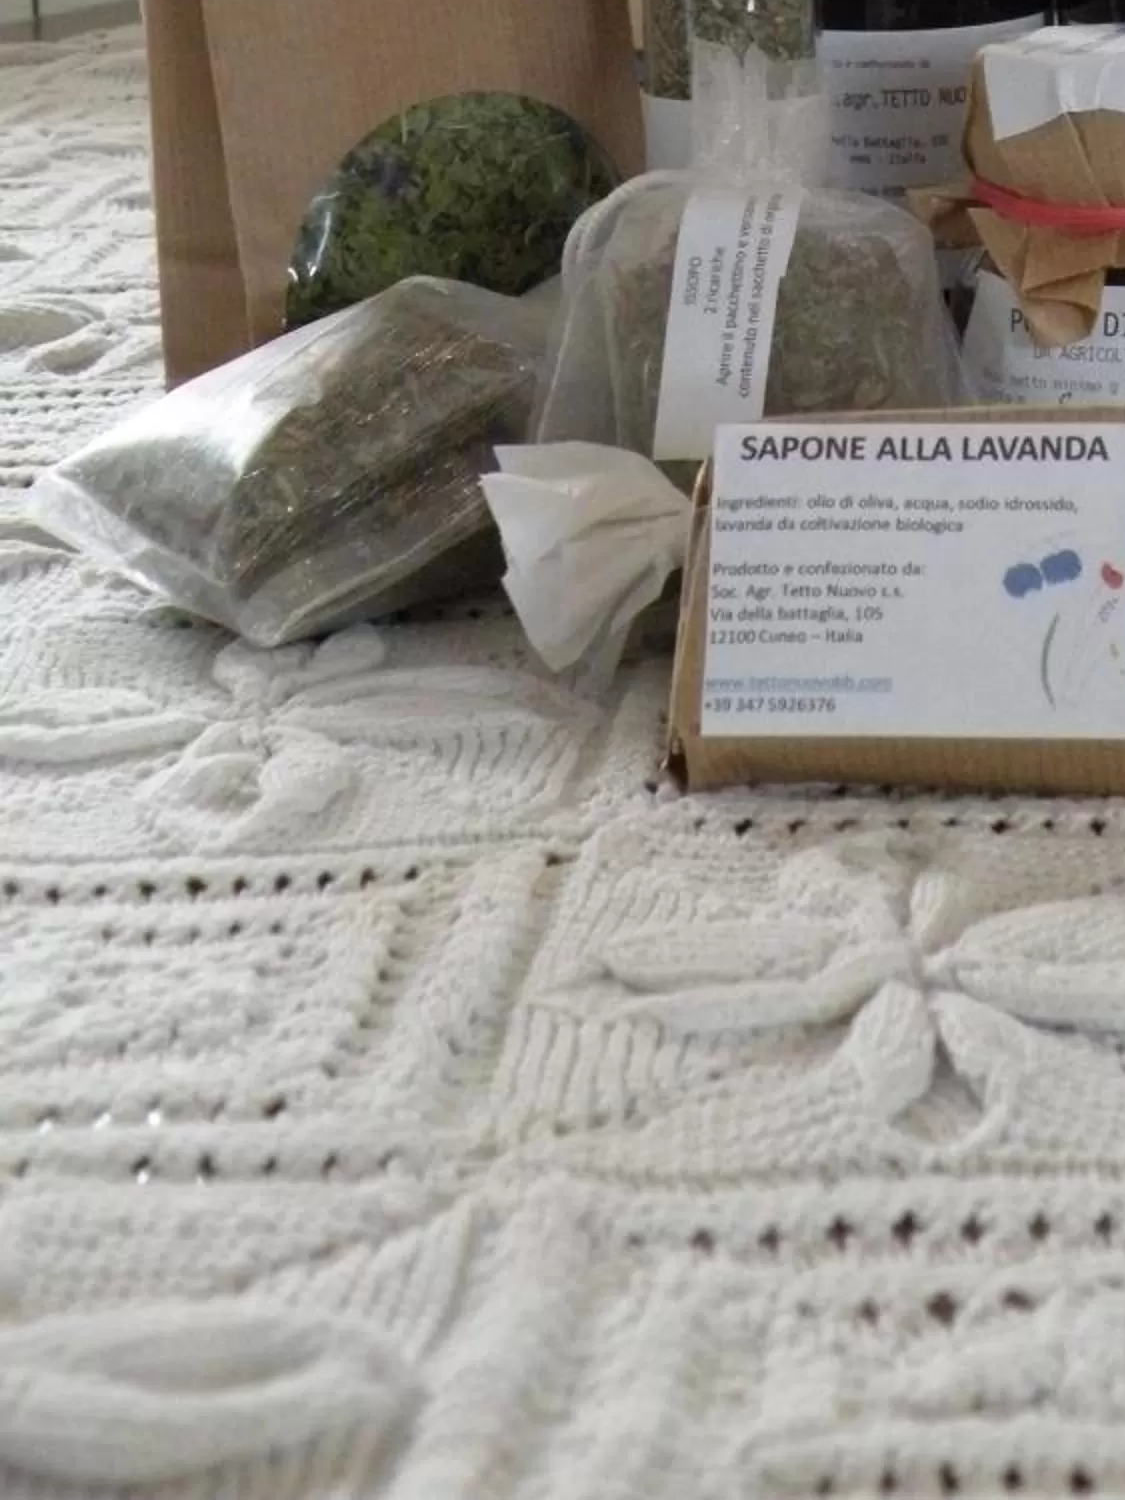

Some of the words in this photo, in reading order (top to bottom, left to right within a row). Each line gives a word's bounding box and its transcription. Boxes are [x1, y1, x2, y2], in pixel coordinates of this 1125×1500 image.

[740, 435, 867, 461] SAPONE
[876, 435, 953, 462] ALLA
[962, 435, 1110, 462] LAVANDA
[806, 494, 836, 510] olio
[958, 496, 1000, 511] sodio
[715, 516, 773, 531] lavanda
[777, 516, 795, 531] da
[800, 517, 891, 531] coltivazione
[895, 517, 964, 534] biologica
[713, 561, 780, 576] Prodotto
[784, 564, 794, 576] e
[797, 561, 897, 576] confezionato
[782, 583, 822, 598] Tetto
[826, 583, 877, 598] Nuovo
[710, 607, 733, 621] Via
[737, 606, 772, 621] della
[758, 629, 807, 643] Cuneo
[825, 628, 863, 643] Italia
